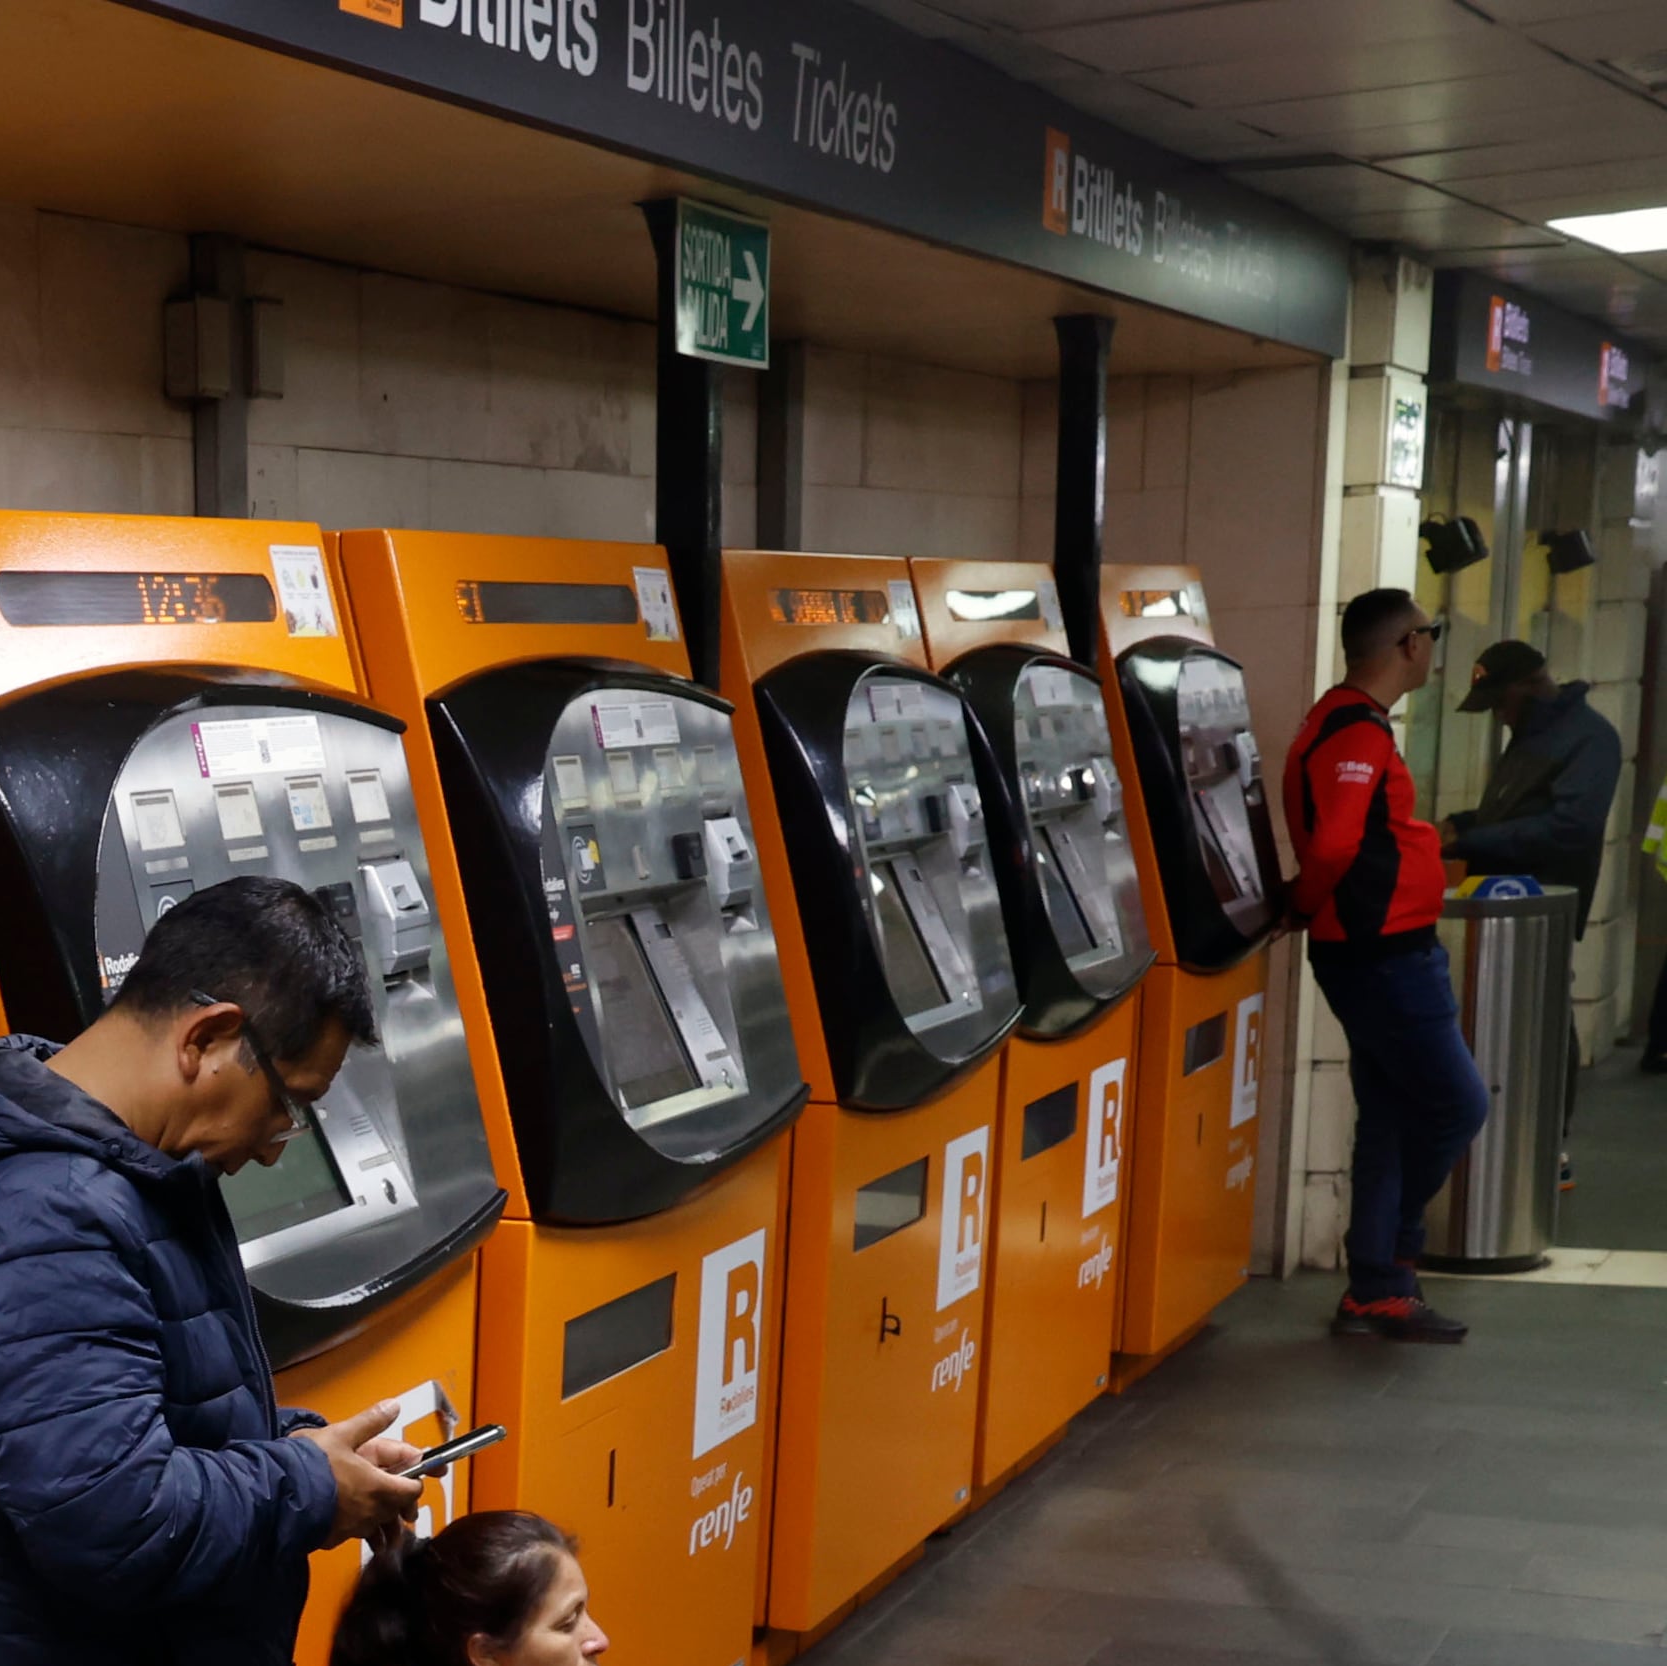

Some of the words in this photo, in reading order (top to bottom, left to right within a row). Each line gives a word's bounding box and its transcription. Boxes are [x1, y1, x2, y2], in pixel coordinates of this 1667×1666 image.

[627, 0, 763, 131] Billetes
[791, 42, 898, 173] Tickets
[1071, 154, 1144, 256] Bitllets
[104, 951, 141, 976] Rodali
[956, 1150, 984, 1256] R
[1078, 1233, 1114, 1291] renfe
[722, 1259, 759, 1388] R
[931, 1327, 976, 1393] renfe
[688, 1470, 754, 1557] renfe
